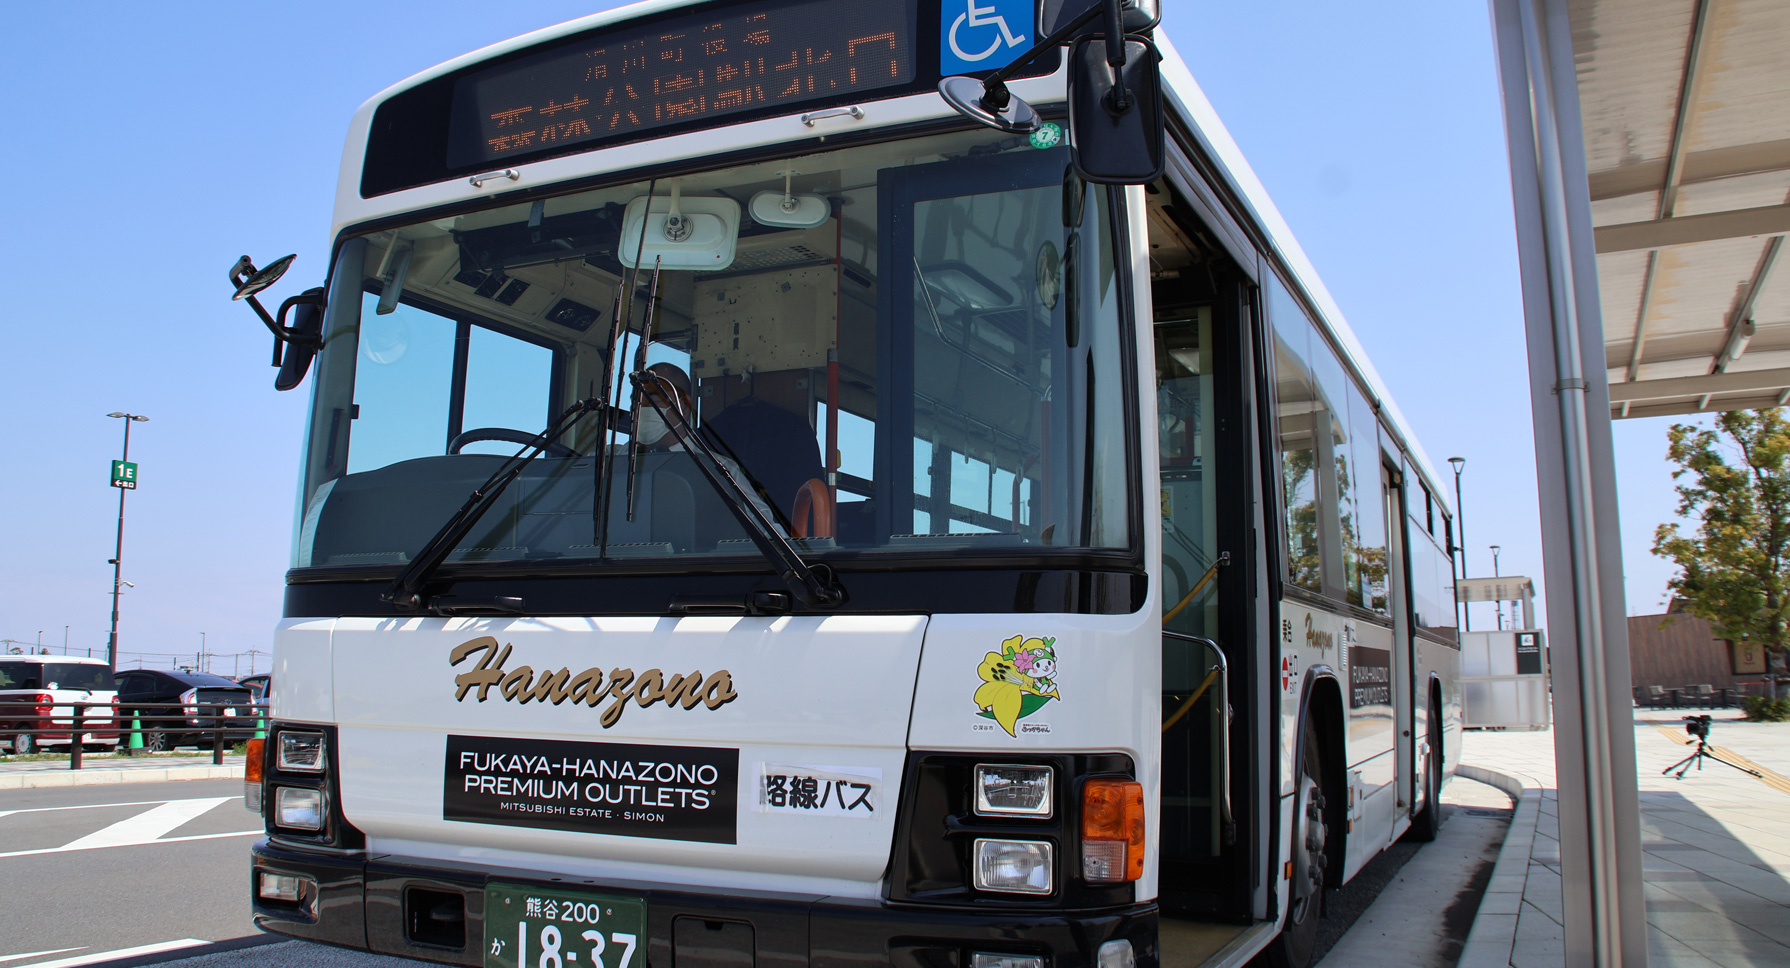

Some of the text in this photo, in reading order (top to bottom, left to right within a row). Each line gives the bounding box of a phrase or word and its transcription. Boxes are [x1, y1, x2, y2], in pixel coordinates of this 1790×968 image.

[1042, 131, 1049, 141] 7
[117, 463, 133, 478] 1E
[449, 635, 738, 729] Hanazono
[460, 751, 718, 786] FUKAYA-HANAZONO
[464, 774, 578, 800] PREMIUM
[761, 774, 874, 812] 路線バス
[500, 801, 665, 823] MITSUBISHI ESTATE SIMON
[490, 921, 637, 968] か 18-37
